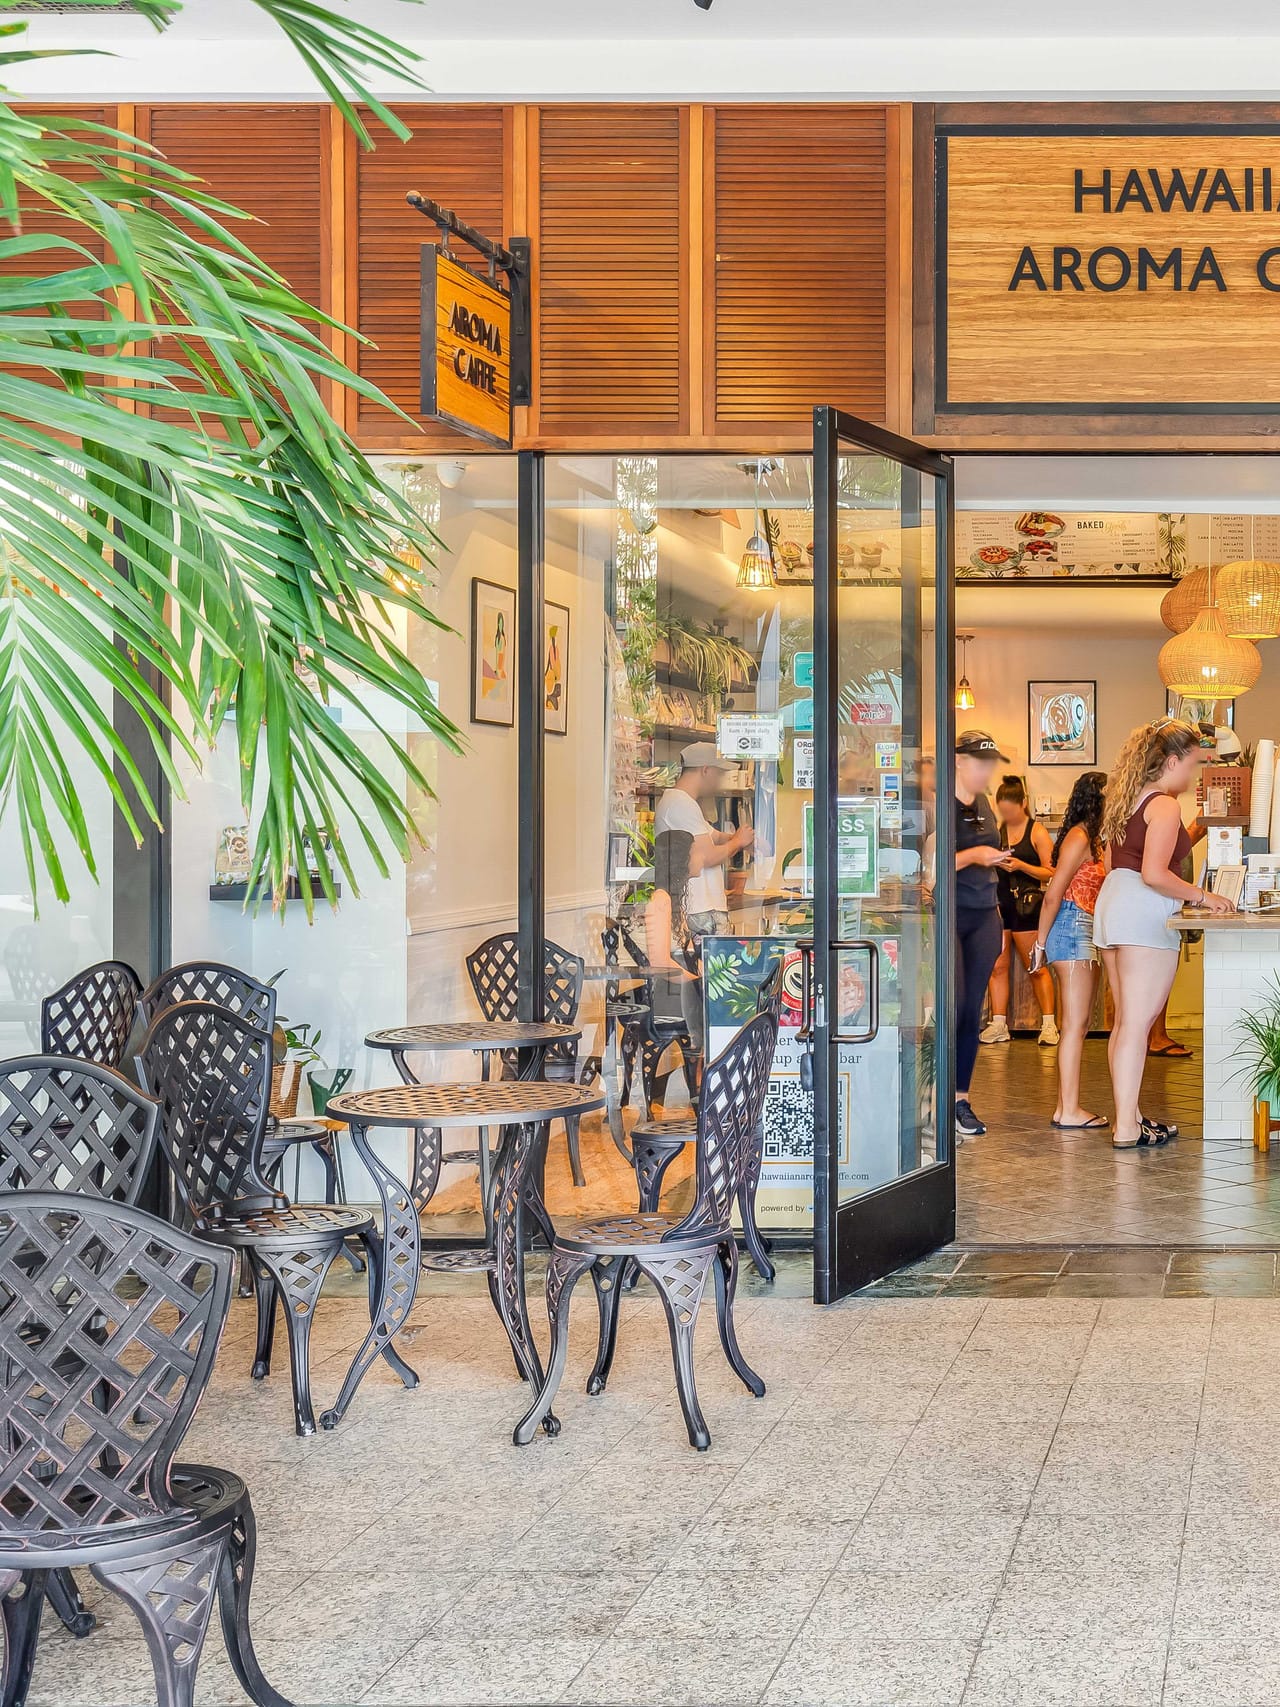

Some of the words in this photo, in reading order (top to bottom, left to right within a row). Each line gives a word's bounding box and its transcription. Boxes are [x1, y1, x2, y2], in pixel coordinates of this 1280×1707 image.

[1008, 246, 1227, 292] AROMA
[449, 301, 502, 356] AROMA
[453, 348, 497, 395] CAFFE
[1077, 521, 1104, 529] BAKED
[840, 1053, 862, 1064] bar
[761, 1205, 793, 1213] powered
[796, 1205, 805, 1213] by
